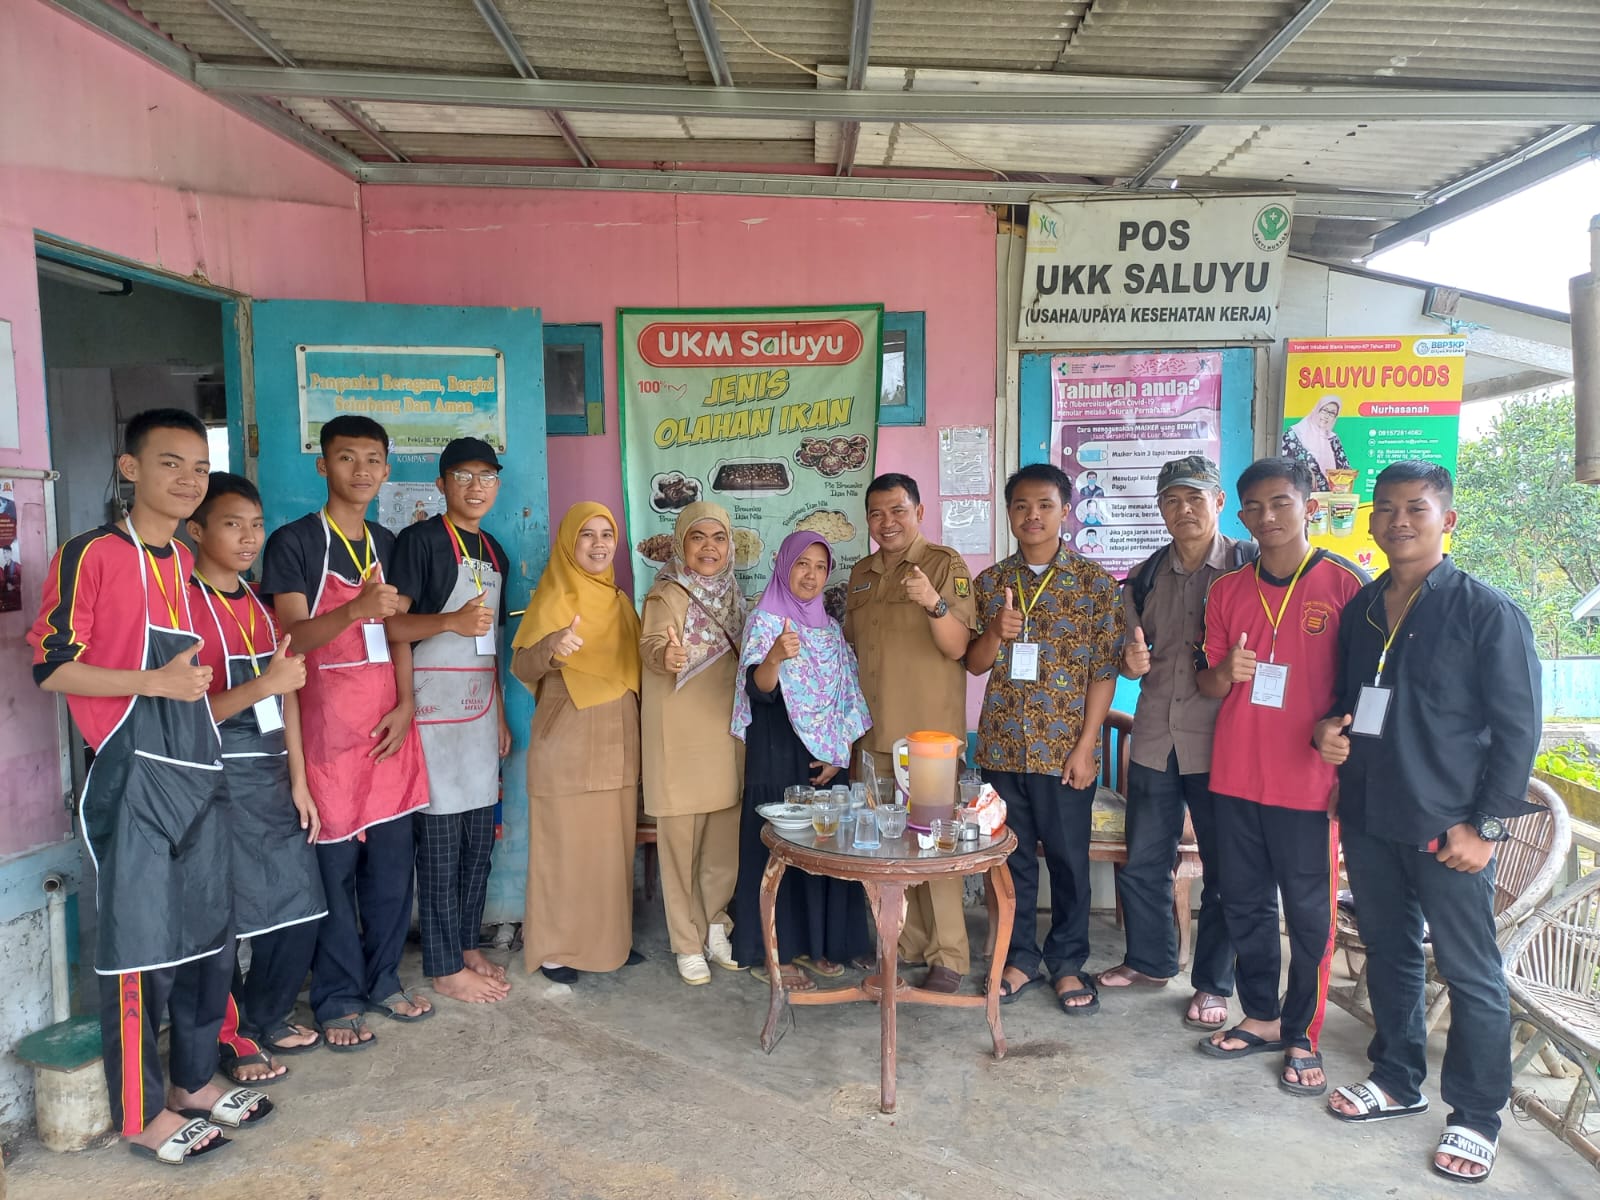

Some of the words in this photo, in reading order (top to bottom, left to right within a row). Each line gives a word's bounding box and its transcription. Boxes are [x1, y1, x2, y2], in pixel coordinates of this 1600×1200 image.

[1118, 220, 1191, 251] POS
[1036, 263, 1112, 295] UKK
[1123, 261, 1270, 294] SALUYU
[1026, 306, 1126, 327] (USAHA/UPAYA
[1130, 306, 1216, 323] KESEHATAN
[1219, 305, 1272, 325] KERJA)
[658, 331, 733, 358] UKM
[740, 330, 843, 362] Saluyu
[310, 373, 379, 394] Panganku
[382, 374, 445, 395] Beragam,
[448, 376, 496, 396] Bergizi
[1298, 366, 1376, 388] SALUYU
[1381, 364, 1450, 387] FOODS
[702, 369, 790, 407] JENIS
[1059, 381, 1137, 400] Tahukah
[1141, 378, 1200, 398] anda?
[335, 396, 400, 414] Seimbang
[404, 398, 431, 412] Dan
[434, 398, 474, 414] Aman
[1126, 398, 1155, 406] Covid-19
[1370, 404, 1430, 414] Nurhasanah
[654, 407, 775, 449] OLAHAN
[778, 396, 855, 434] IKAN
[1160, 424, 1176, 432] yang
[397, 455, 426, 463] KOMPAS
[824, 481, 834, 489] Pie
[1112, 475, 1138, 484] Menutupi
[1112, 484, 1127, 492] Dagu
[1112, 504, 1128, 512] Tetap
[222, 1088, 258, 1110] VANS
